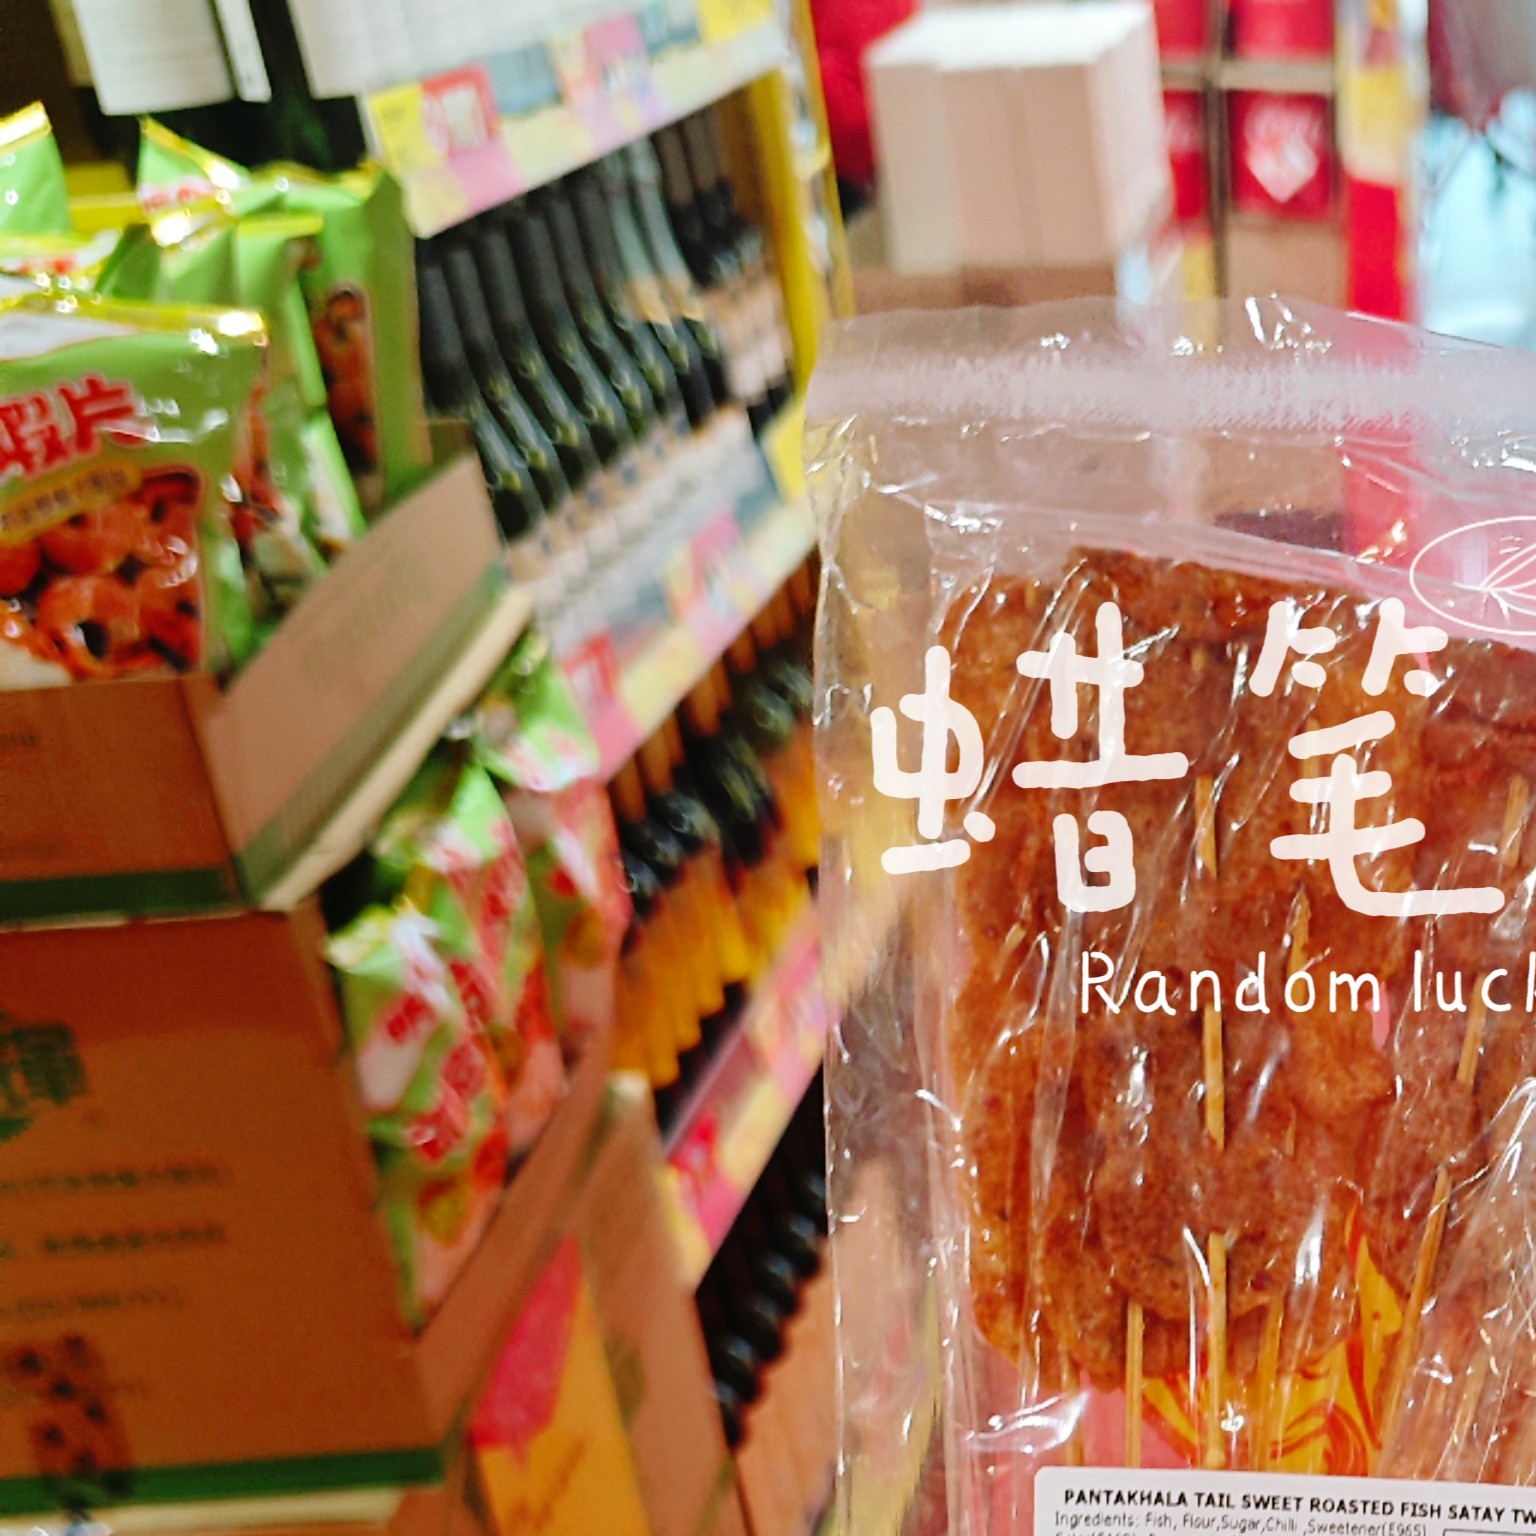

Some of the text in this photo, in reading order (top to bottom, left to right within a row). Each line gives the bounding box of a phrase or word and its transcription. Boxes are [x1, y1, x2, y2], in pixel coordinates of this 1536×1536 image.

[1064, 1489, 1188, 1507] PANTAKHALA
[1195, 1492, 1235, 1508] TAIL
[1242, 1494, 1304, 1512] SWEET
[1310, 1497, 1394, 1516] ROASTED
[1400, 1502, 1441, 1518] FISH
[1448, 1504, 1505, 1522] SATAY
[1055, 1511, 1140, 1530] Ingredients:
[1145, 1511, 1178, 1531] Fish,
